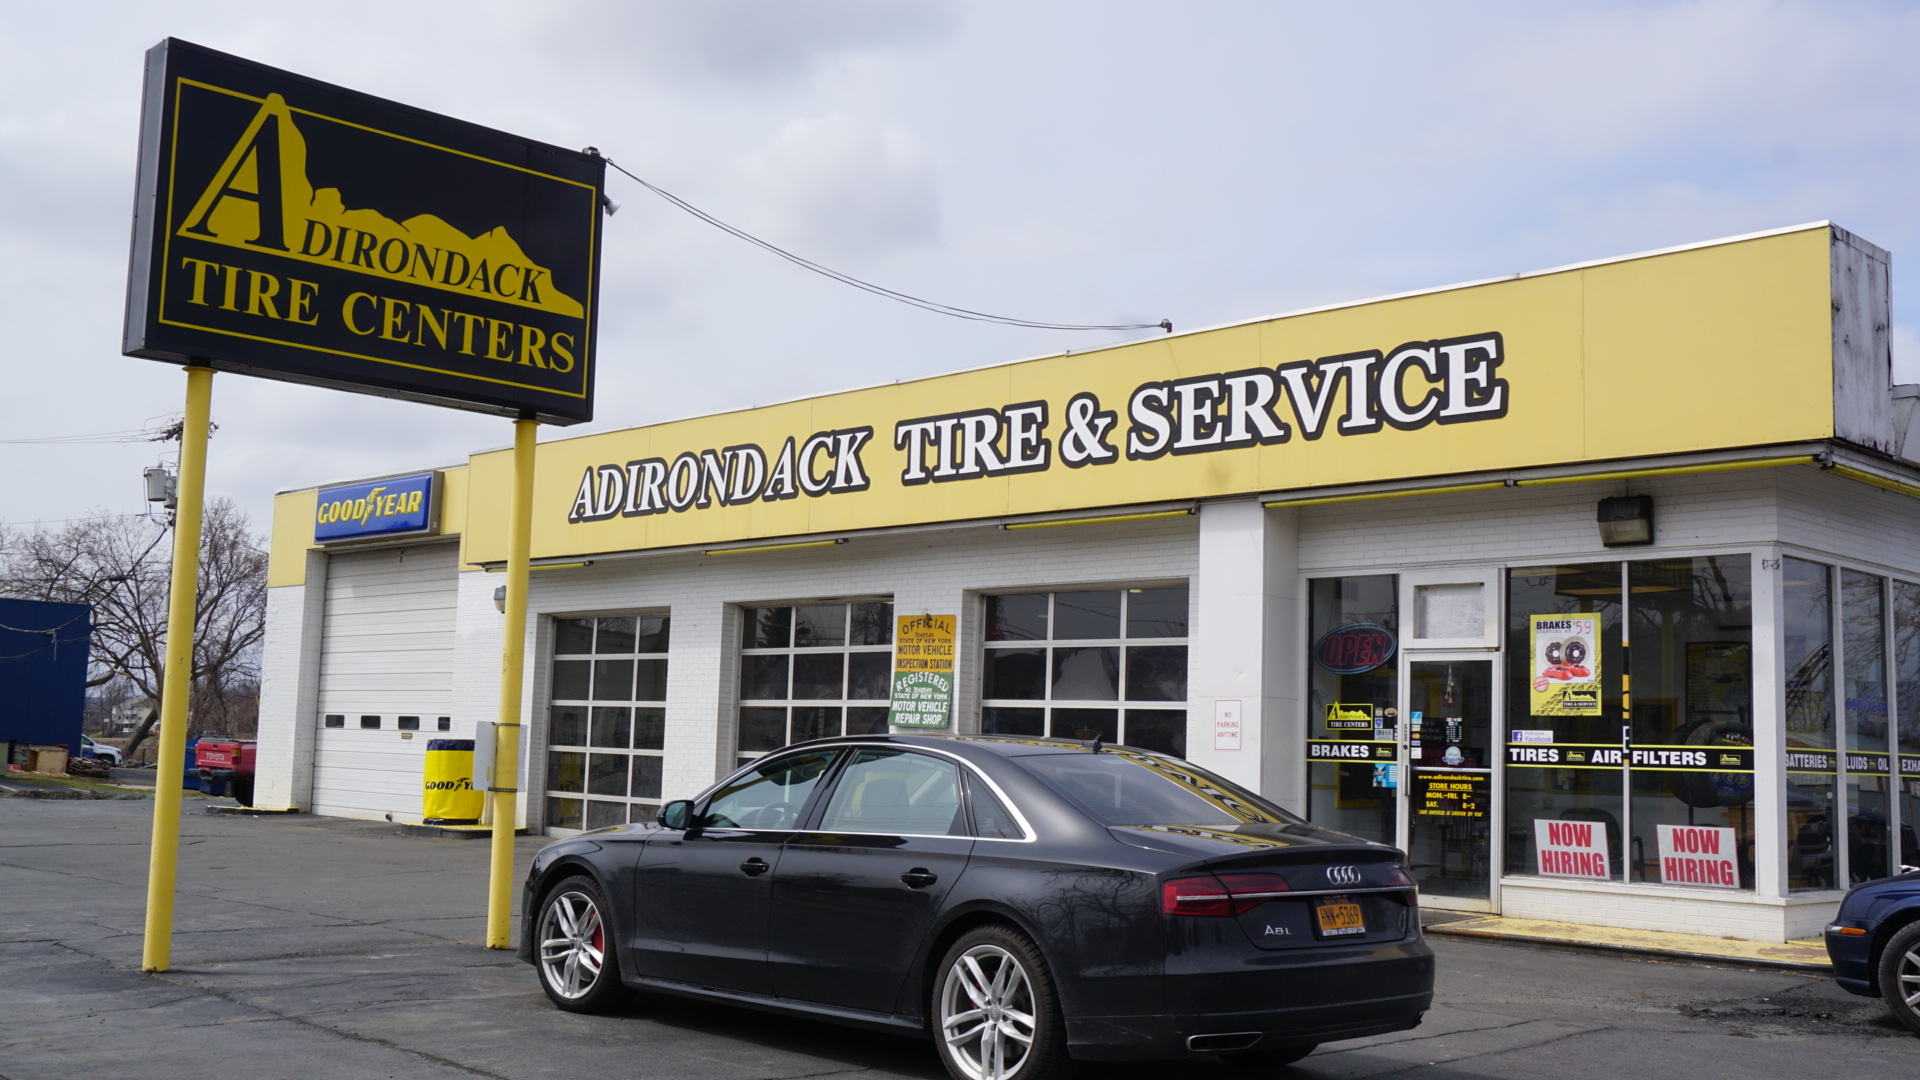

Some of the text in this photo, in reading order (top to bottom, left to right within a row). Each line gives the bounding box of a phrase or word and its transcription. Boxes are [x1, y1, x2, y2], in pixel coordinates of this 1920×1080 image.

[180, 95, 547, 304] ADIRONDACK
[182, 257, 574, 373] TIRE CENTERS
[569, 332, 1507, 521] ADIRONDACK TIRE & SERVICE
[317, 489, 423, 525] GOODYEAR
[902, 618, 951, 634] OFFICIAL
[1536, 621, 1571, 629] BRAKES
[898, 645, 952, 655] MOTOR VEHICLE
[1322, 634, 1388, 666] OPEN
[897, 659, 952, 669] INSPECTION STATION
[896, 672, 949, 692] REGISTERED
[892, 701, 947, 712] MOTOR VEHICLE
[1846, 697, 1888, 714] OODYEAR
[895, 713, 942, 725] REPAIR SHOP
[1311, 744, 1369, 758] BRAKES
[1510, 748, 1559, 763] TIRES
[1592, 750, 1622, 764] AIR
[1632, 751, 1707, 766] FILTERS
[1786, 754, 1827, 768] BATTERIES
[1846, 756, 1868, 770] LUIDS
[1878, 758, 1889, 770] OIL
[425, 780, 473, 790] GOODY
[1548, 822, 1592, 847] NOW
[1672, 828, 1719, 854] NOW
[1541, 850, 1605, 877] HIRING
[1664, 857, 1734, 885] HIRING
[1339, 905, 1359, 925] 5369
